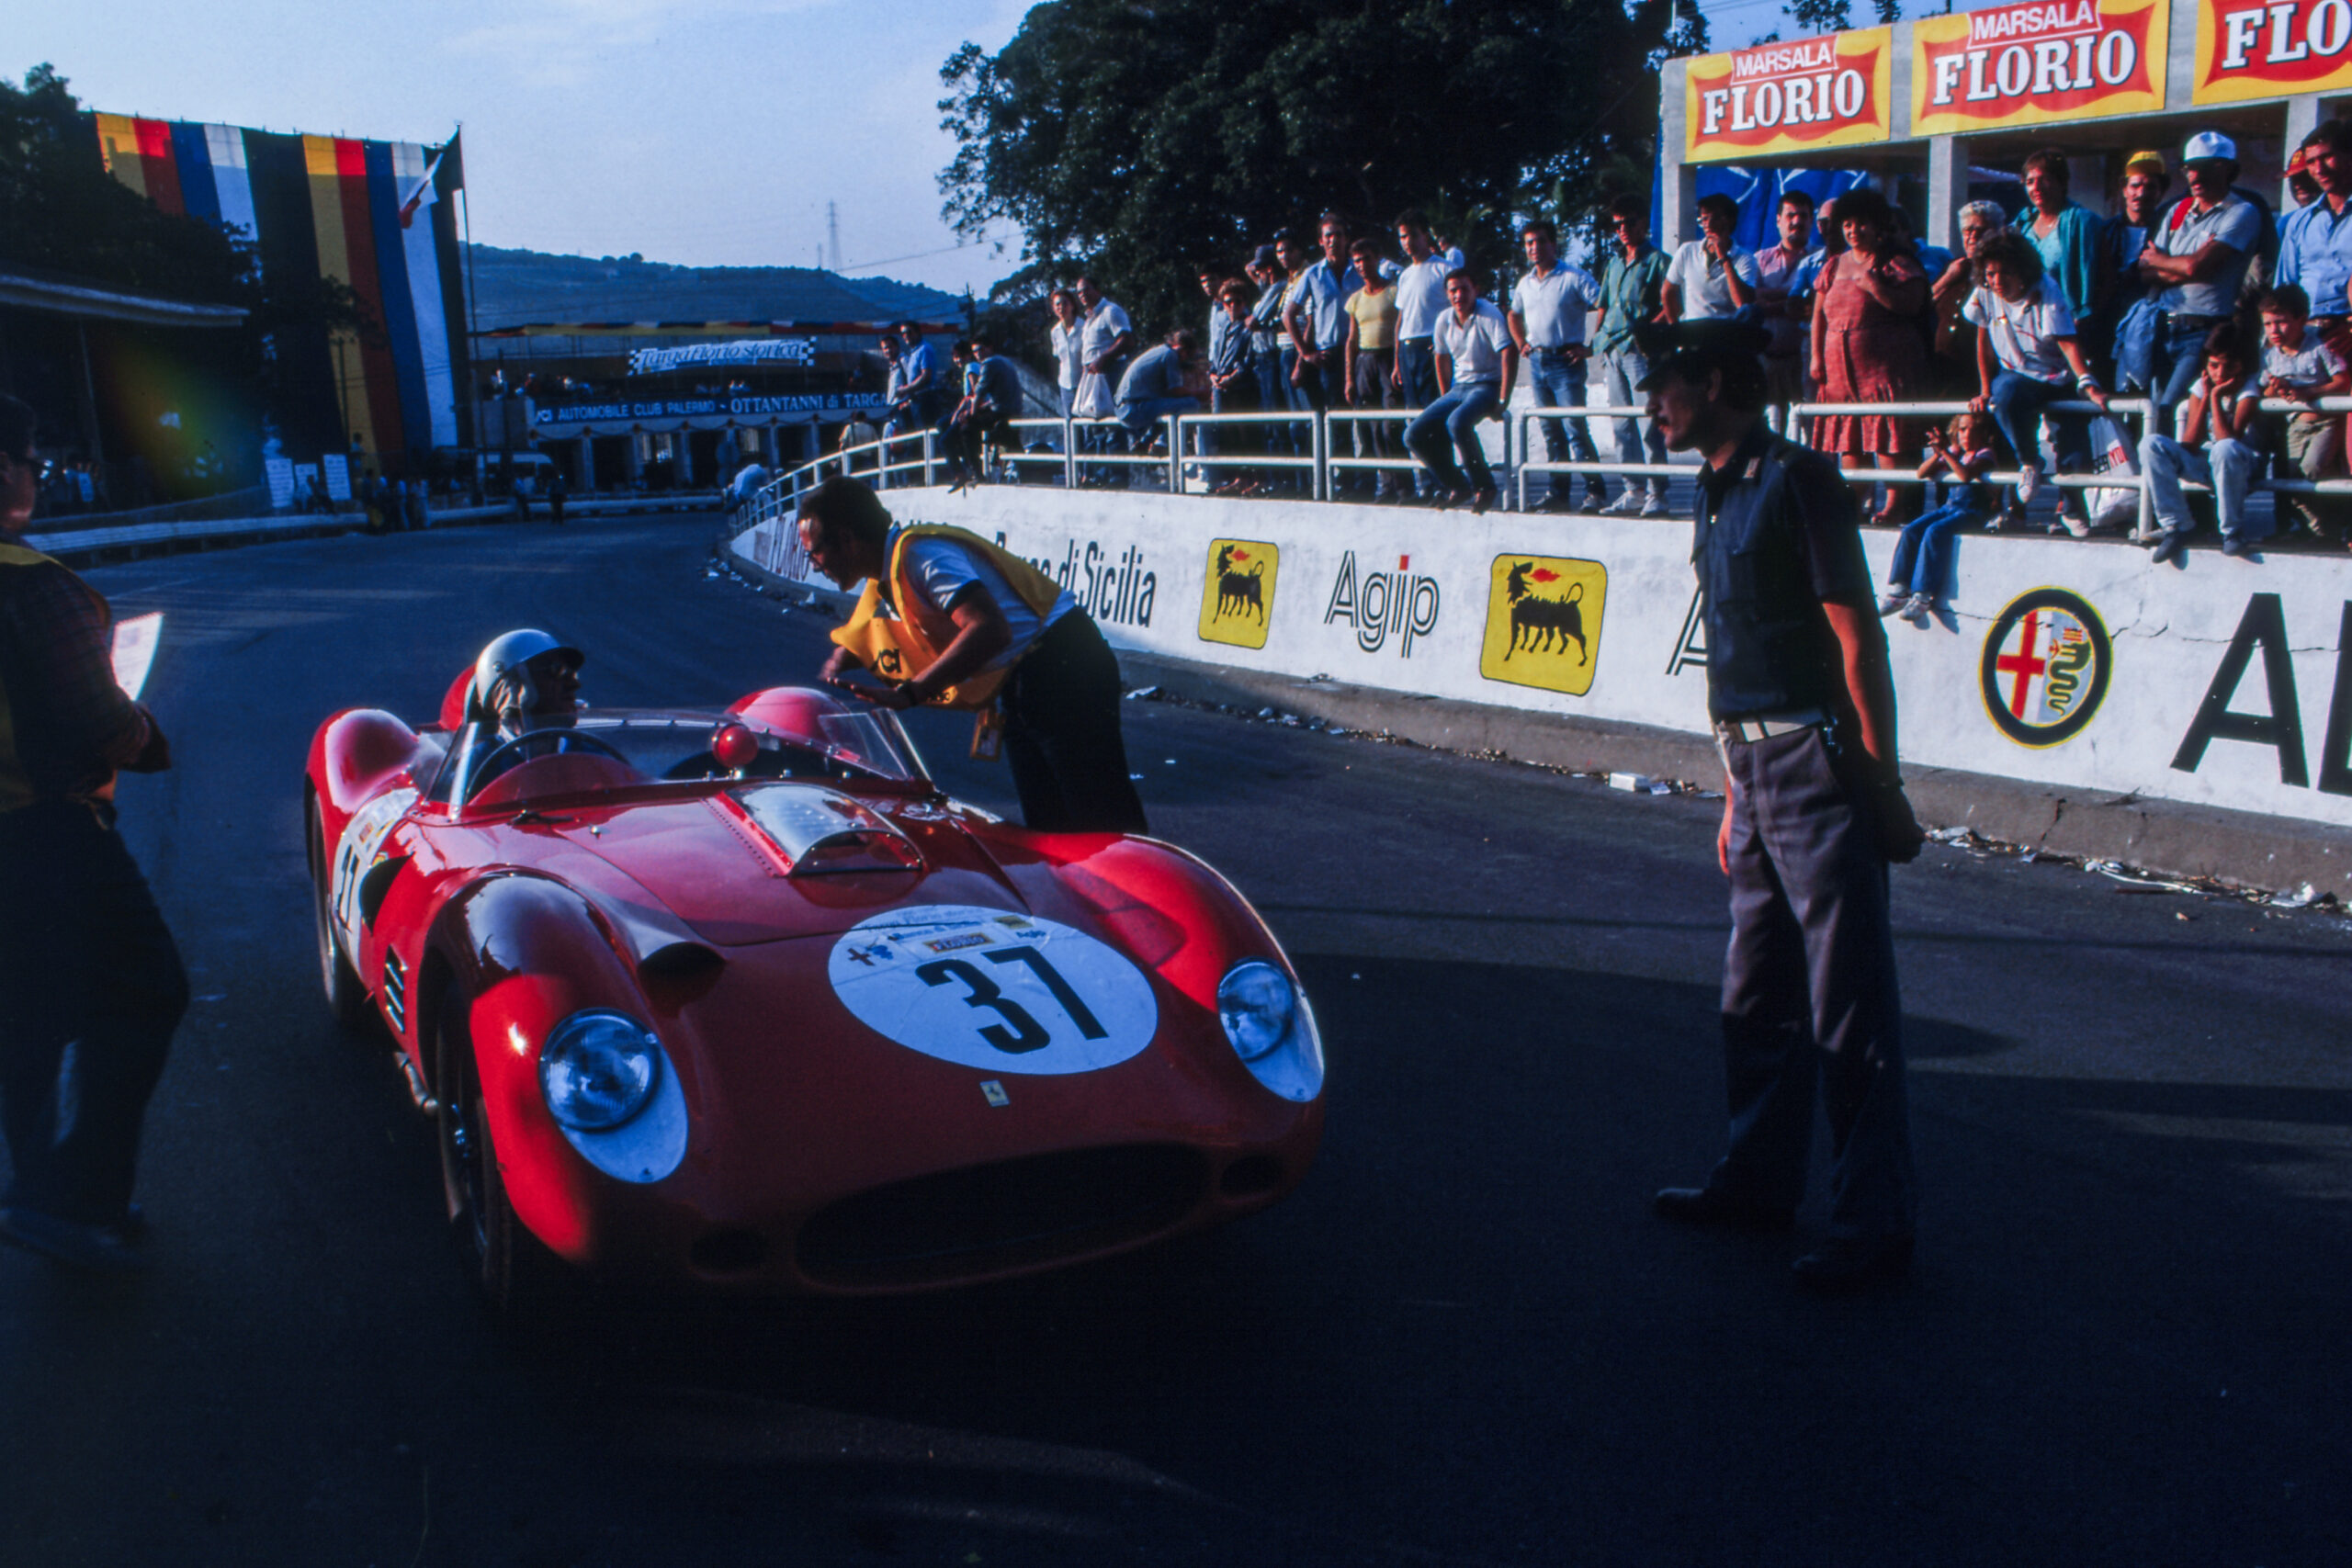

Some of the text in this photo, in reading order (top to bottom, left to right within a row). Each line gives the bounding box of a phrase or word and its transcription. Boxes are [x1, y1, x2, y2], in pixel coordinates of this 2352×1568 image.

[1975, 1, 2093, 40] MARSALA
[1736, 42, 1832, 77] MARSALA
[1933, 29, 2138, 106] FLORIO
[1702, 69, 1866, 134] FLORIO
[559, 405, 629, 421] AUTOMOBILE
[634, 402, 662, 416] CLUB
[667, 400, 716, 414] PALERMO
[730, 395, 823, 413] OTTANTANNI
[827, 394, 838, 408] di
[1079, 540, 1157, 628] Sicilia
[1324, 549, 1441, 659] Agip
[915, 945, 1111, 1055] 37
